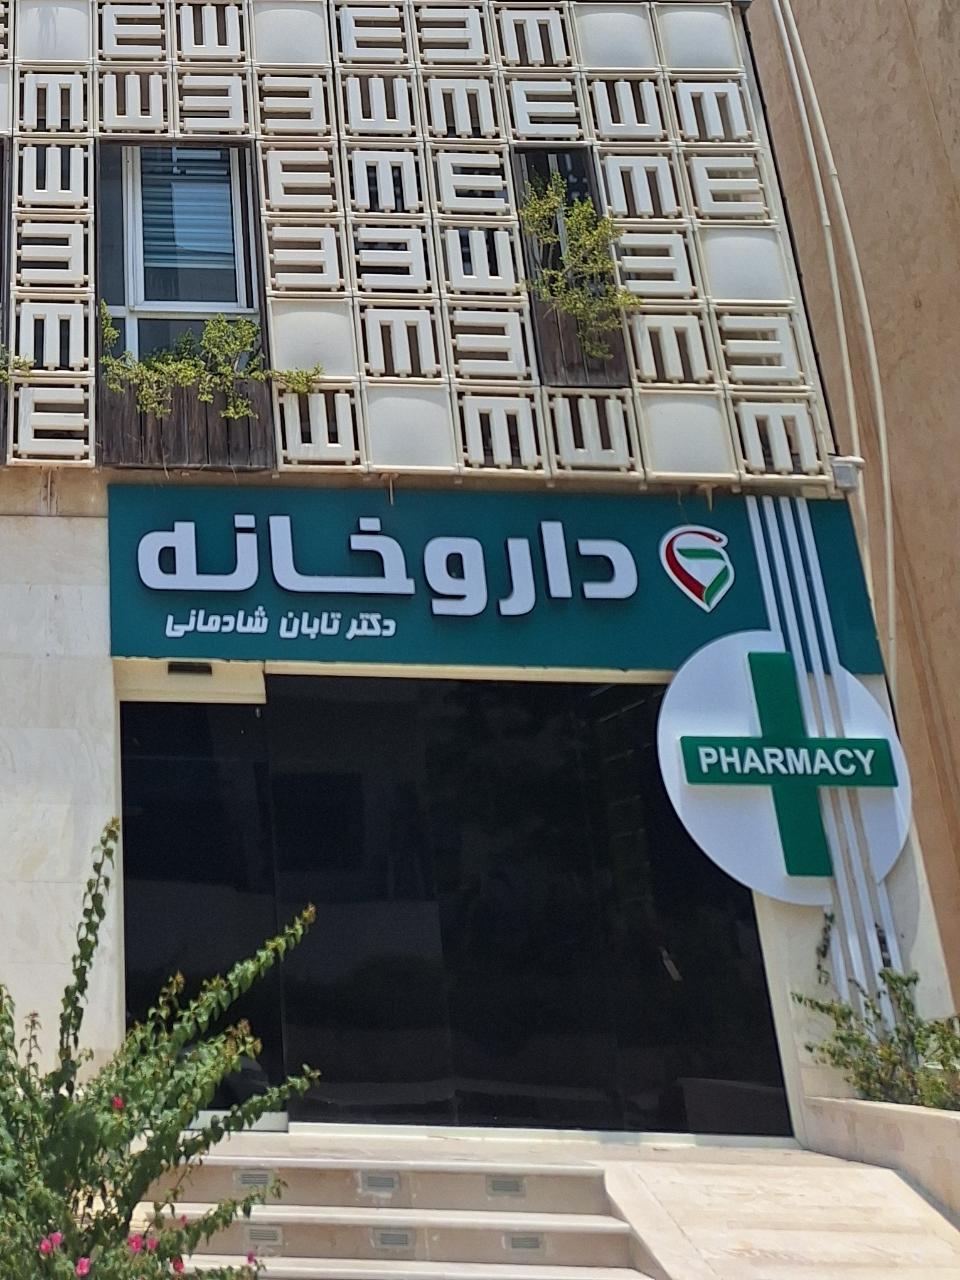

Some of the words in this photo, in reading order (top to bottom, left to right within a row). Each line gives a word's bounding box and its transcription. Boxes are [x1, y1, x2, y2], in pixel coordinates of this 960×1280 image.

[137, 513, 639, 617] داروخانه
[165, 605, 269, 638] شادمانی
[279, 611, 342, 639] تابان
[345, 611, 397, 640] دکتر
[697, 746, 875, 776] PHARMACY
